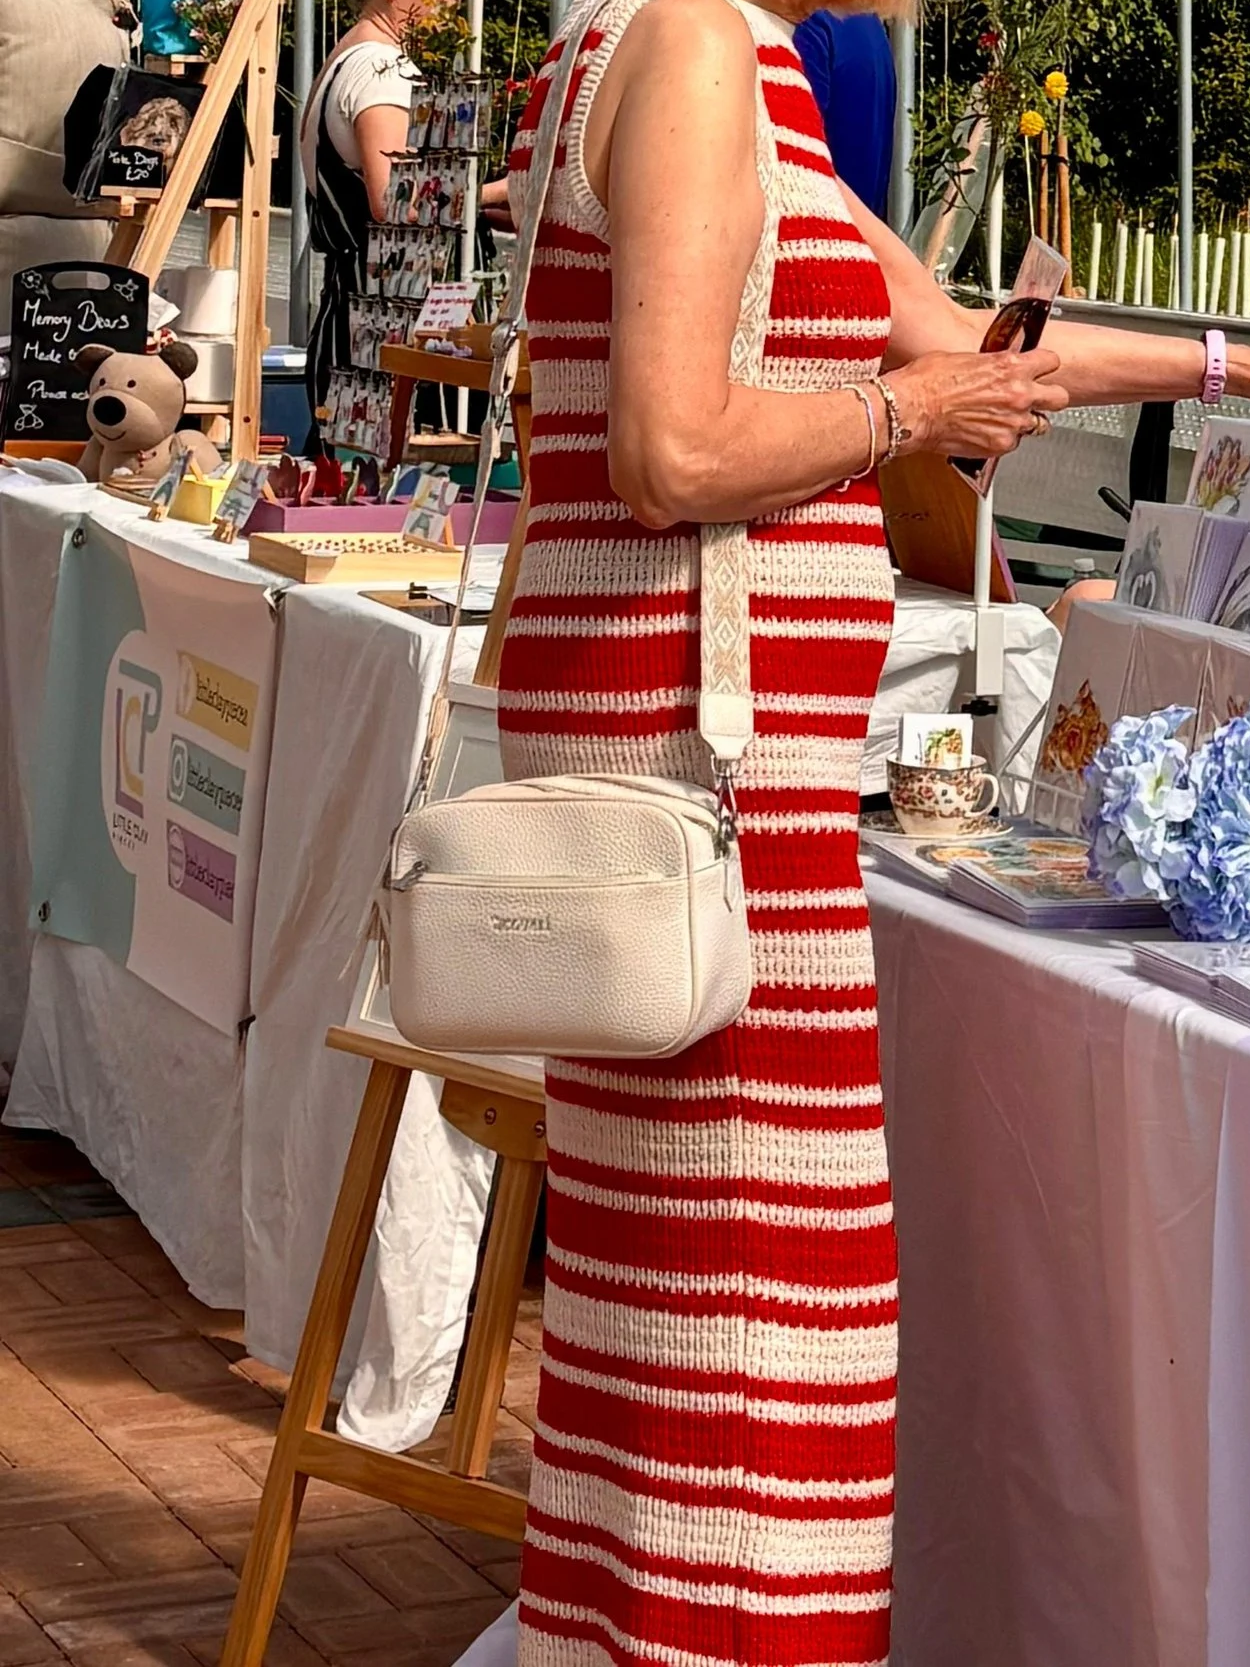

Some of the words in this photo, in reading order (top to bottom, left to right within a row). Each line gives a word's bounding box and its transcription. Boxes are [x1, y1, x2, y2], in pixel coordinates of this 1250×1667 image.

[23, 298, 72, 343] Memory
[77, 300, 129, 332] Bears
[23, 340, 62, 363] Made
